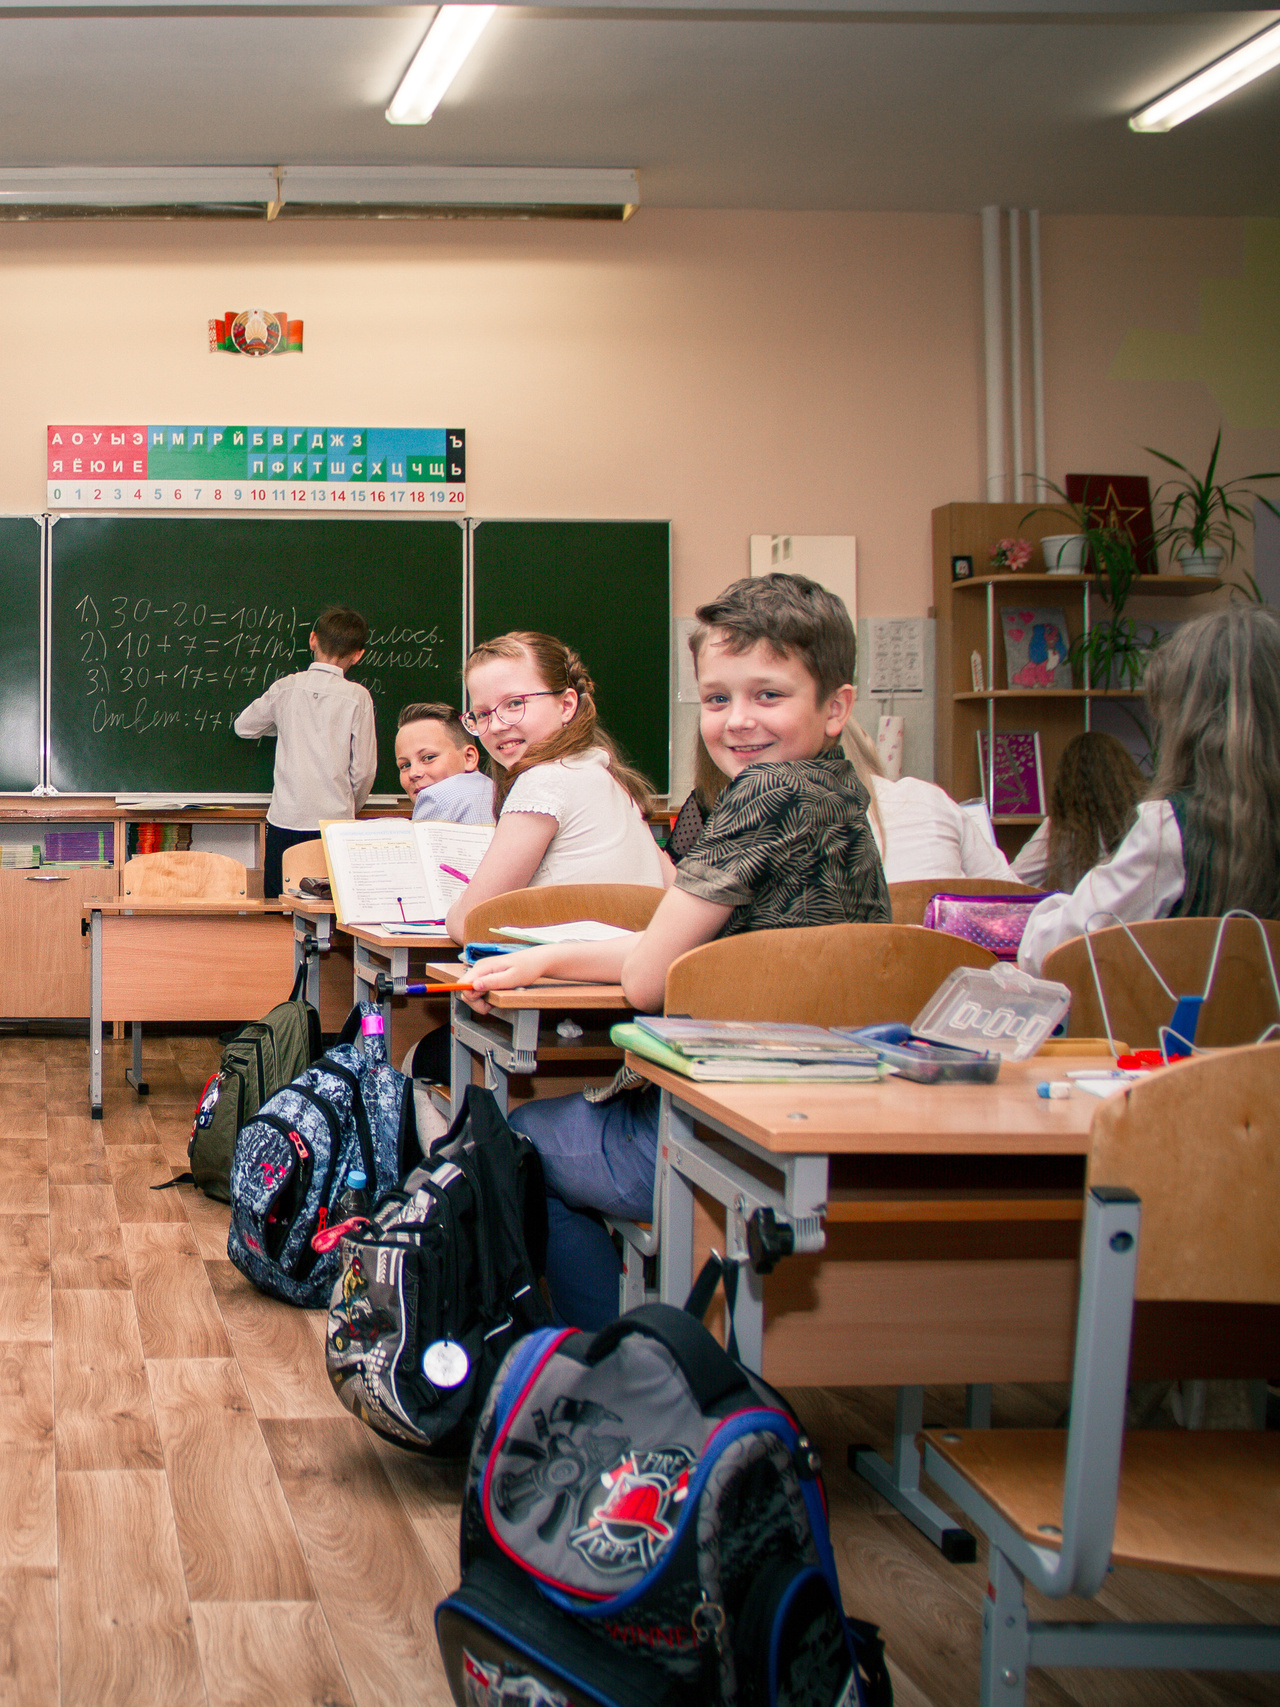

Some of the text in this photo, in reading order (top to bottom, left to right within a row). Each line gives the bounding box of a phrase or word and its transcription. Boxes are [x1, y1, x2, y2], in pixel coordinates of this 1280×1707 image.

[52, 432, 462, 448] А О У Ы Э Н М Л Р Й Б В Г Д Ж З Ъ
[53, 458, 461, 477] Я Ё Ю И Е П Ф К Т Ш С Х Ц Ч Щ Ь
[54, 489, 465, 503] 0 1 2 3 4 5 6 7 8 9 10 11 12 13 14 15 16 17 18 19 20
[194, 709, 222, 732] 47
[641, 1451, 686, 1474] FIRE
[586, 1537, 637, 1565] DEPT
